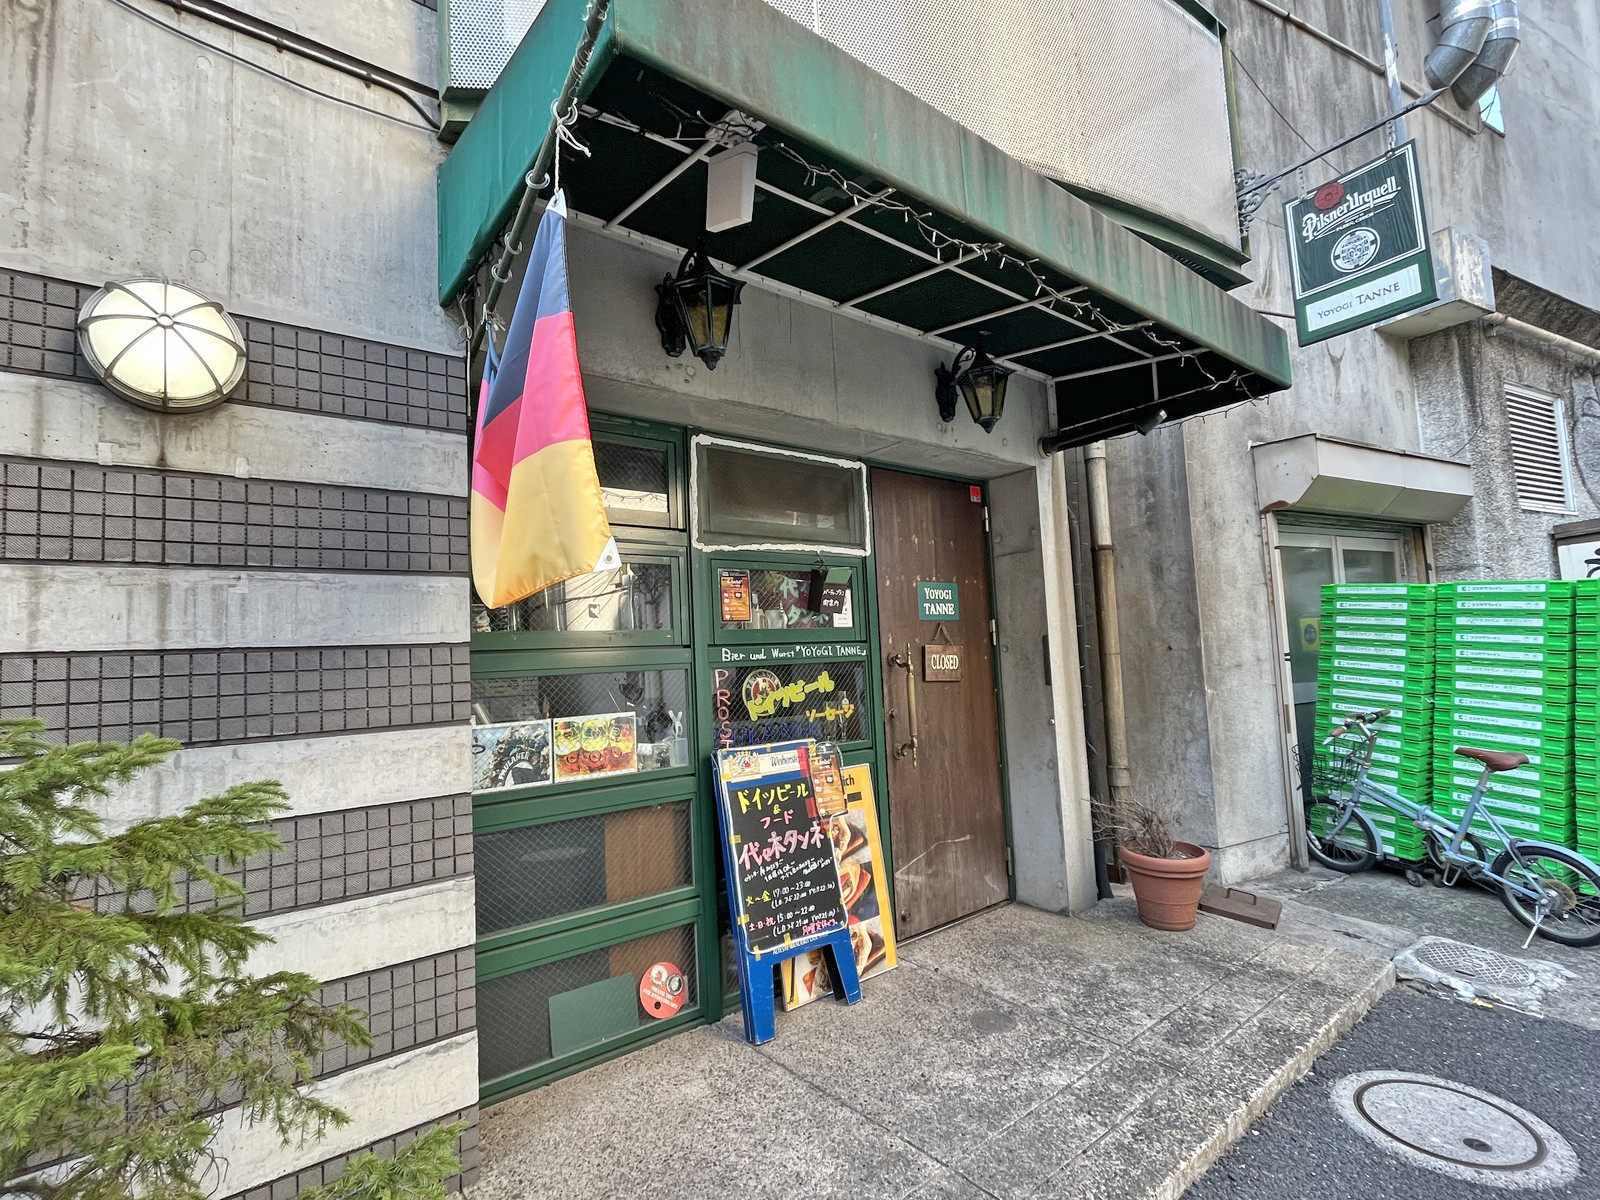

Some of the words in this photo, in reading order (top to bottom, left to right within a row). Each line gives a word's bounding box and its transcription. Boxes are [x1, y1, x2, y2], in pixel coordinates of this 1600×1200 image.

[1302, 202, 1349, 243] Pilsner
[1317, 302, 1353, 319] YOYOGI
[1356, 282, 1400, 305] TANNE
[924, 587, 952, 600] YOYOGI
[924, 603, 955, 615] TANNE
[721, 648, 745, 662] Bier
[749, 648, 767, 660] und
[771, 648, 795, 658] Wurst
[931, 654, 958, 670] CLOSED
[737, 783, 809, 814] ドイツビール
[773, 804, 782, 814] &
[760, 809, 794, 829] フード
